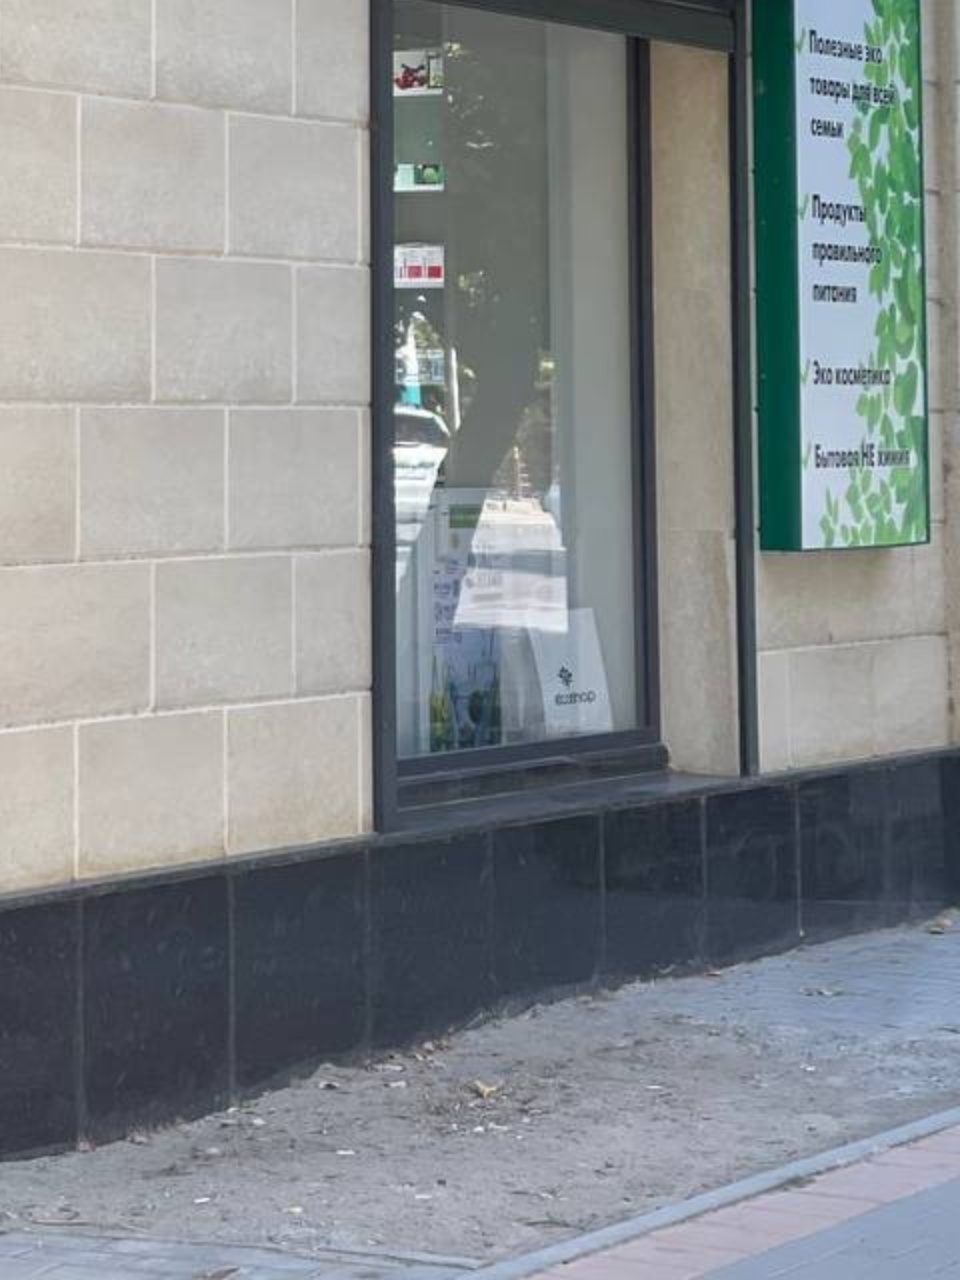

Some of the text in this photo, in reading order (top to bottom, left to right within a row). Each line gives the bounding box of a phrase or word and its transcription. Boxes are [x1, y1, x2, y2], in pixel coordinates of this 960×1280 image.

[809, 29, 883, 64] Полезные эко
[809, 77, 851, 104] товары
[852, 83, 871, 103] для
[811, 118, 844, 139] семьи
[812, 194, 866, 228] Продукты
[812, 242, 883, 267] правильного
[812, 283, 857, 304] питания
[813, 359, 891, 386] Эко косметика
[815, 444, 859, 468] Бытовая
[861, 443, 875, 467] НЕ
